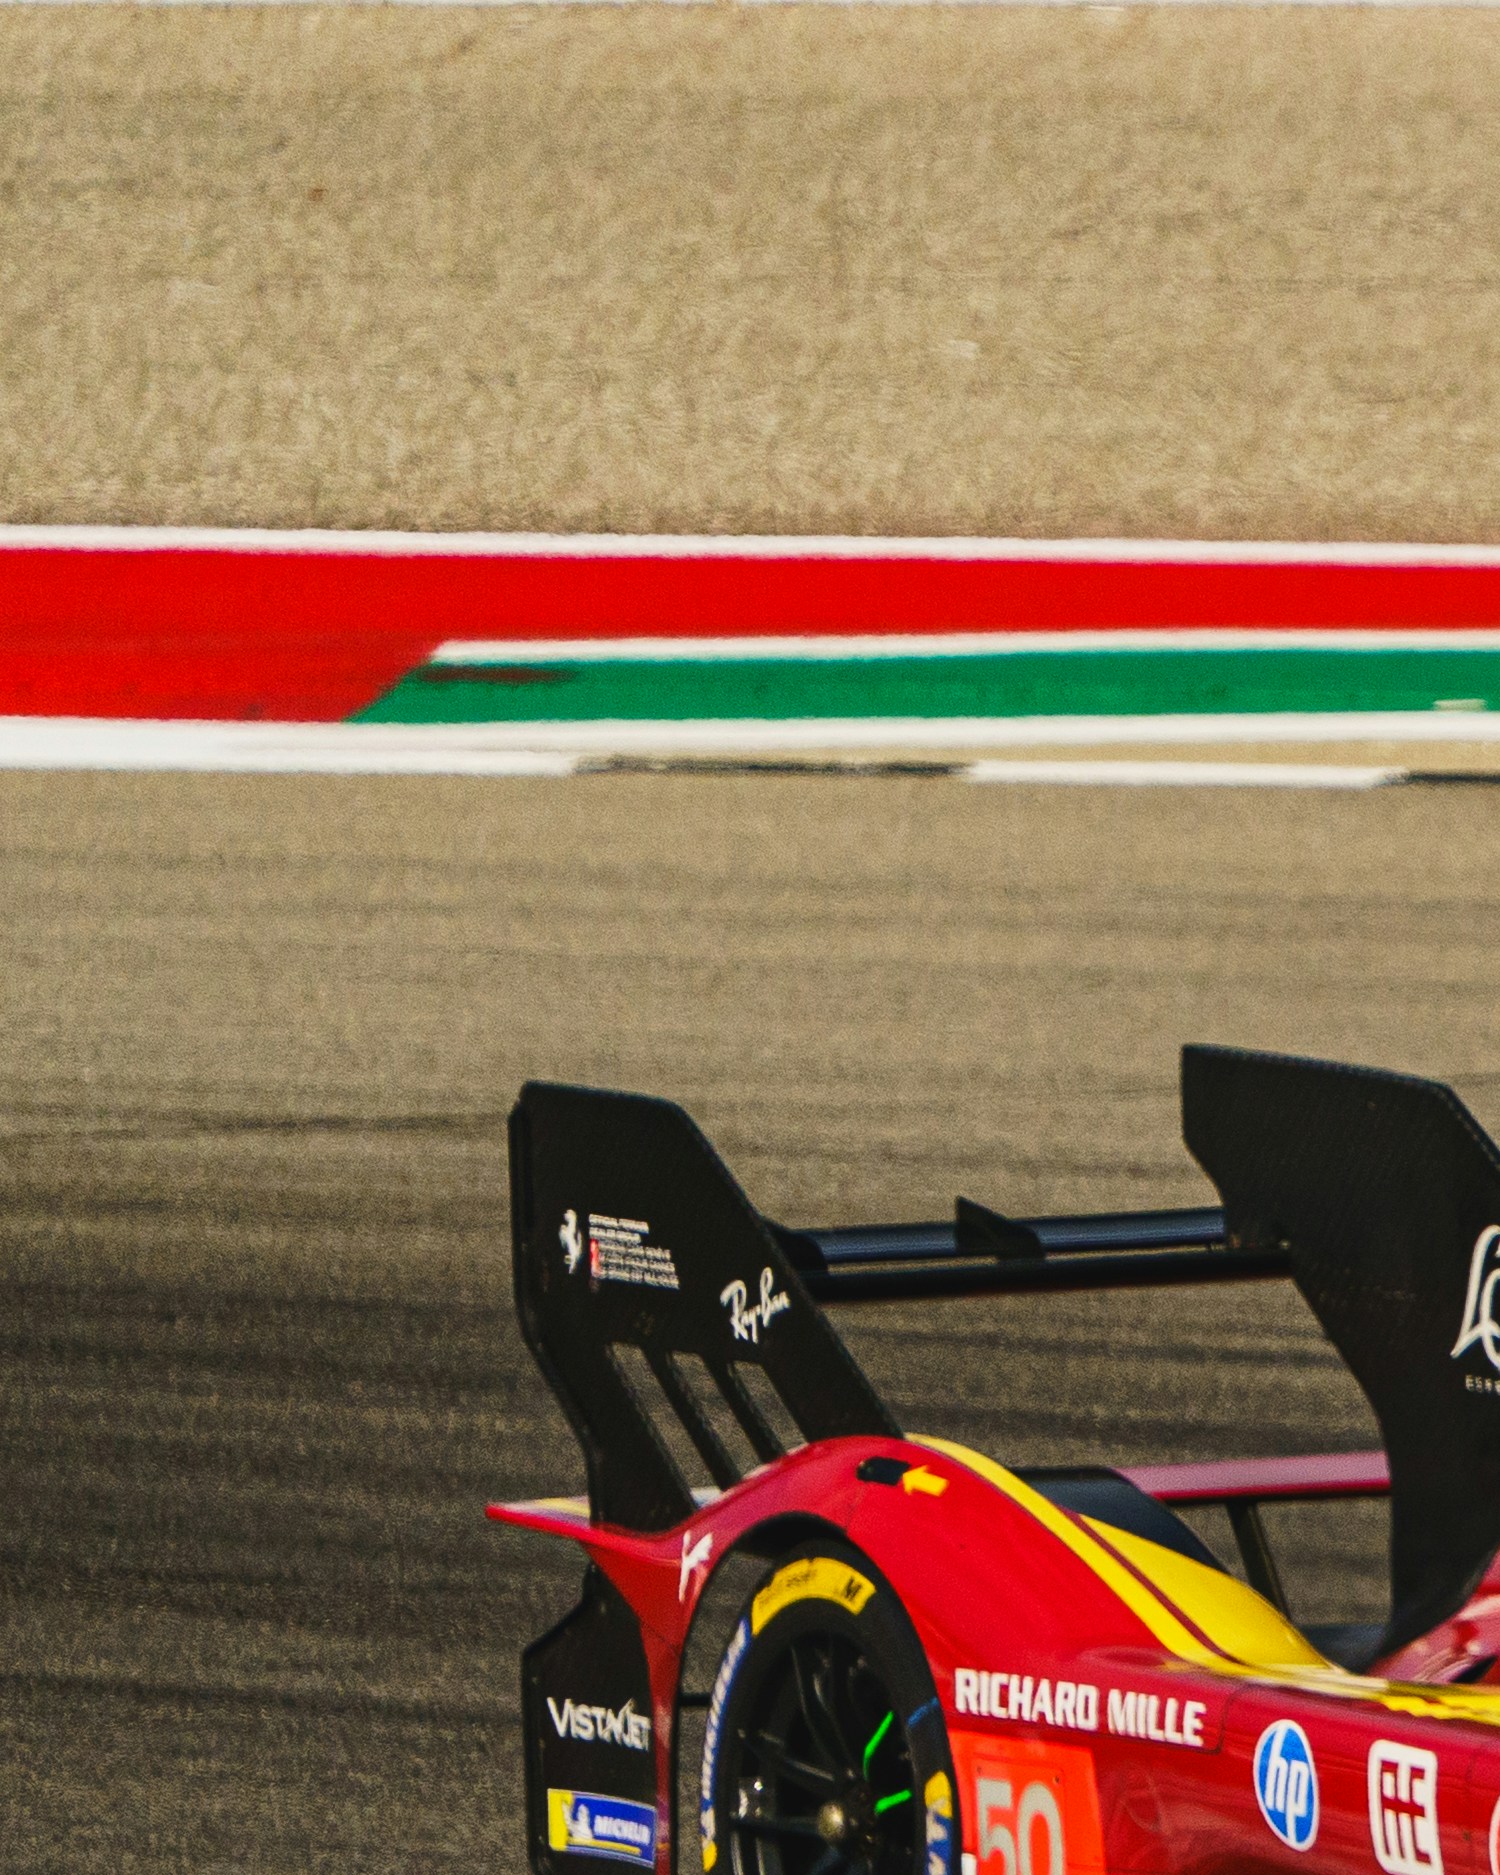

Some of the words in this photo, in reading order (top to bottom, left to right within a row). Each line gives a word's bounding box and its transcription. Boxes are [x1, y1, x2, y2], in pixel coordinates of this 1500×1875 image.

[954, 1667, 1100, 1733] RICHARD
[1106, 1688, 1208, 1748] MILLE
[1264, 1722, 1312, 1843] hp
